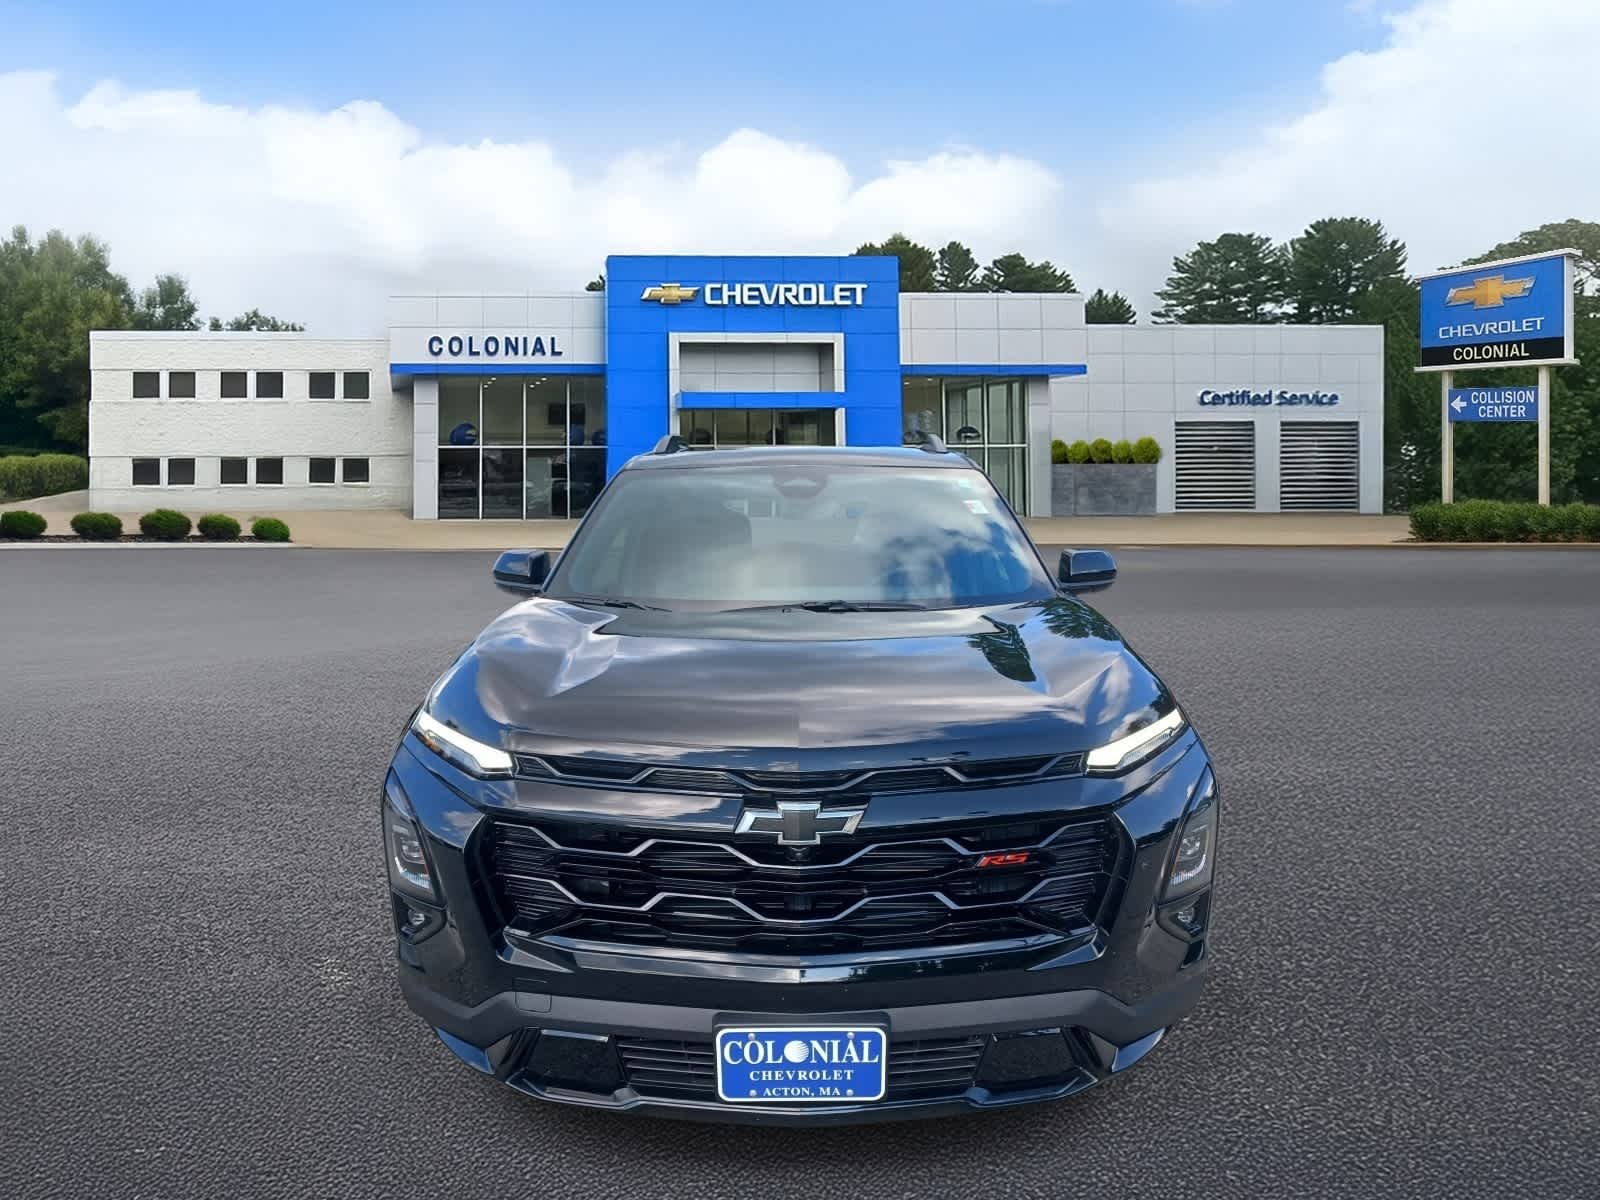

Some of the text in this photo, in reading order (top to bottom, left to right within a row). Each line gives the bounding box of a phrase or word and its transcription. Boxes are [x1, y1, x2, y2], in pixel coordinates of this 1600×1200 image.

[704, 283, 868, 305] CHEVROLET
[1439, 316, 1545, 339] CHEVROLET
[428, 336, 563, 357] COLONIAL
[1453, 343, 1530, 361] COLONIAL
[1199, 390, 1339, 406] Certified Service
[1471, 390, 1535, 404] COLLISION
[1478, 405, 1526, 418] CENTER
[977, 851, 1029, 868] RS
[723, 1040, 879, 1065] COLONIAL
[750, 1069, 855, 1081] CHEVROLET
[763, 1087, 841, 1097] ACTON, MA
